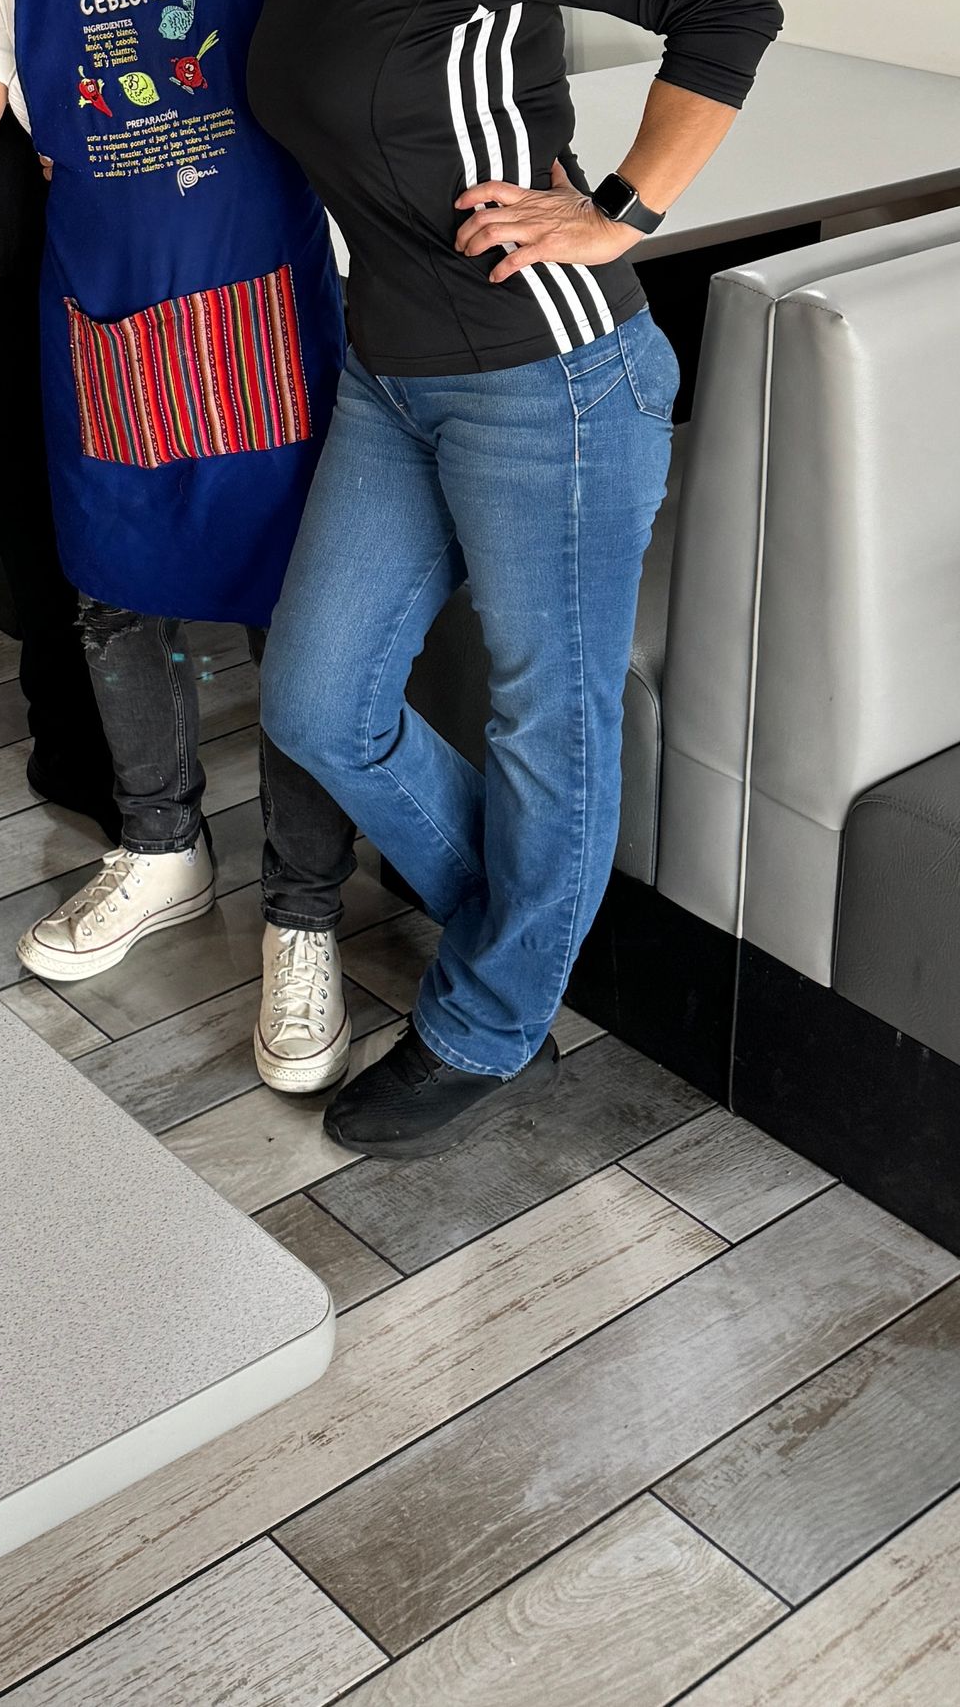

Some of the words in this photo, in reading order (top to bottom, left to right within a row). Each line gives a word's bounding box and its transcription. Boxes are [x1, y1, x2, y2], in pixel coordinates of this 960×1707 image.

[83, 19, 132, 34] INGREDIENTES
[88, 32, 114, 42] Pescado
[126, 109, 178, 129] PREPARACIÓN
[109, 132, 131, 141] pescado
[212, 128, 235, 140] pescado
